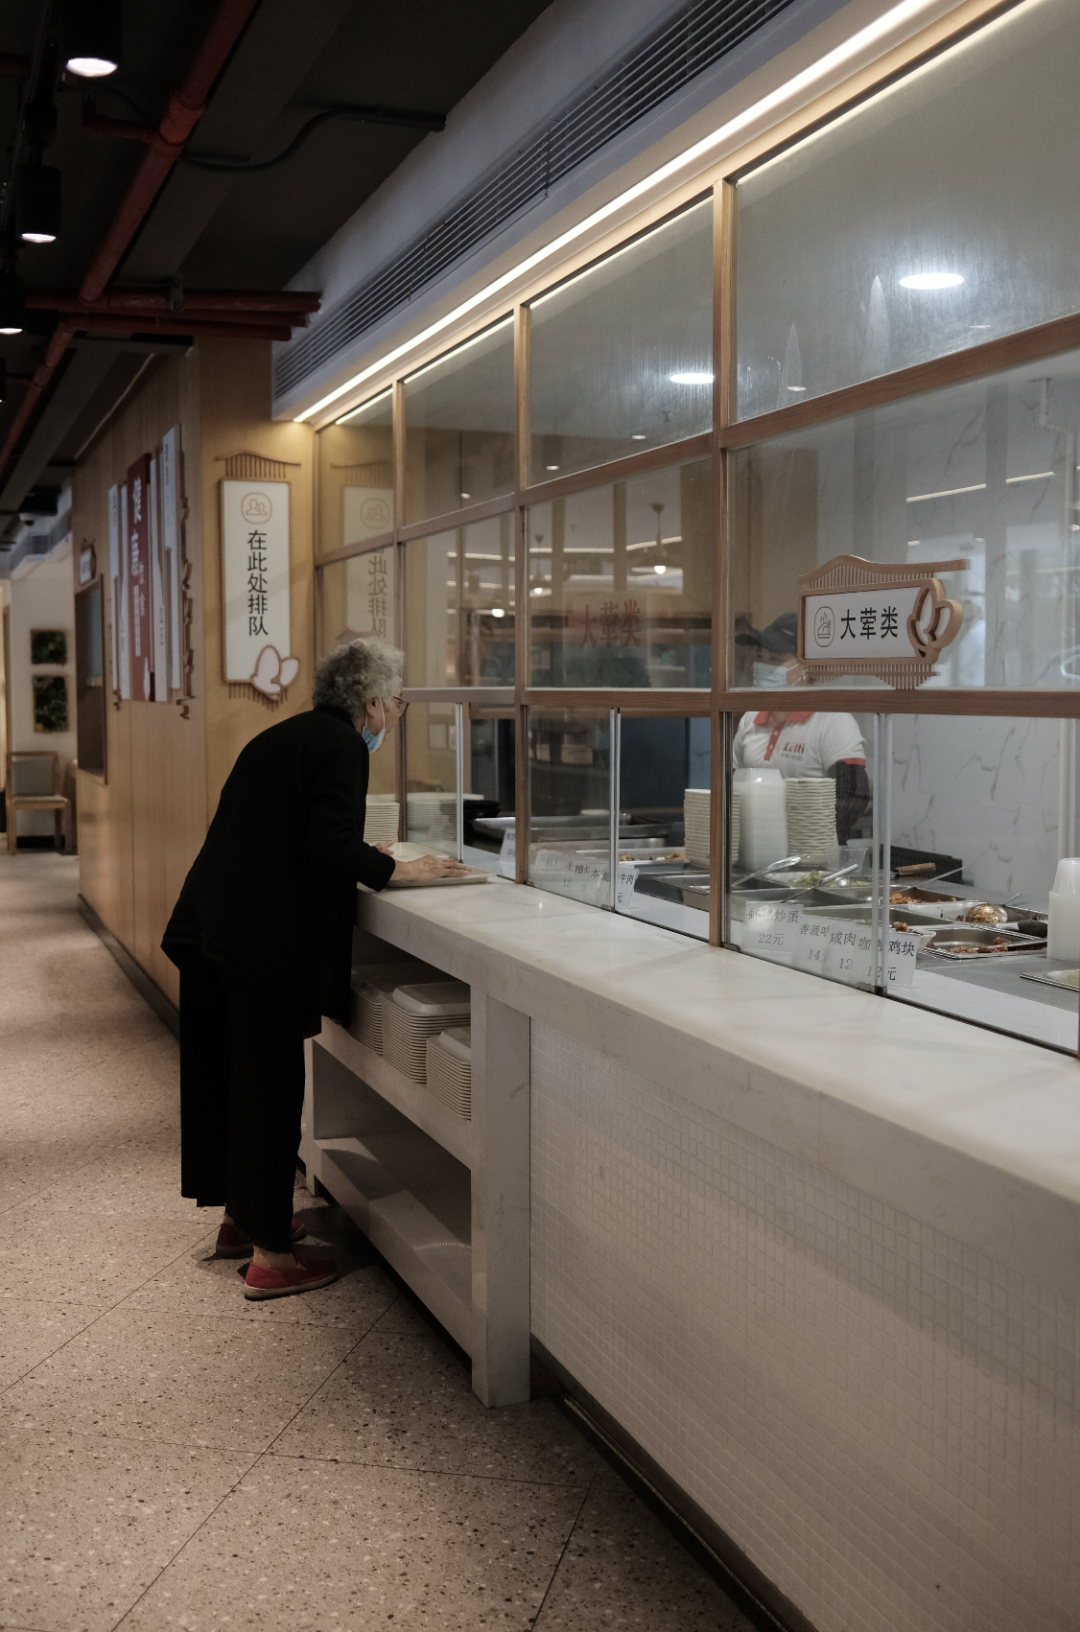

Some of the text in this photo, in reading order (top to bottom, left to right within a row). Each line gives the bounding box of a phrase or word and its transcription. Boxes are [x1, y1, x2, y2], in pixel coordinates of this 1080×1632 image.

[247, 529, 269, 637] 在此处排队
[840, 606, 899, 640] 大荤类
[758, 933, 785, 946] 22元
